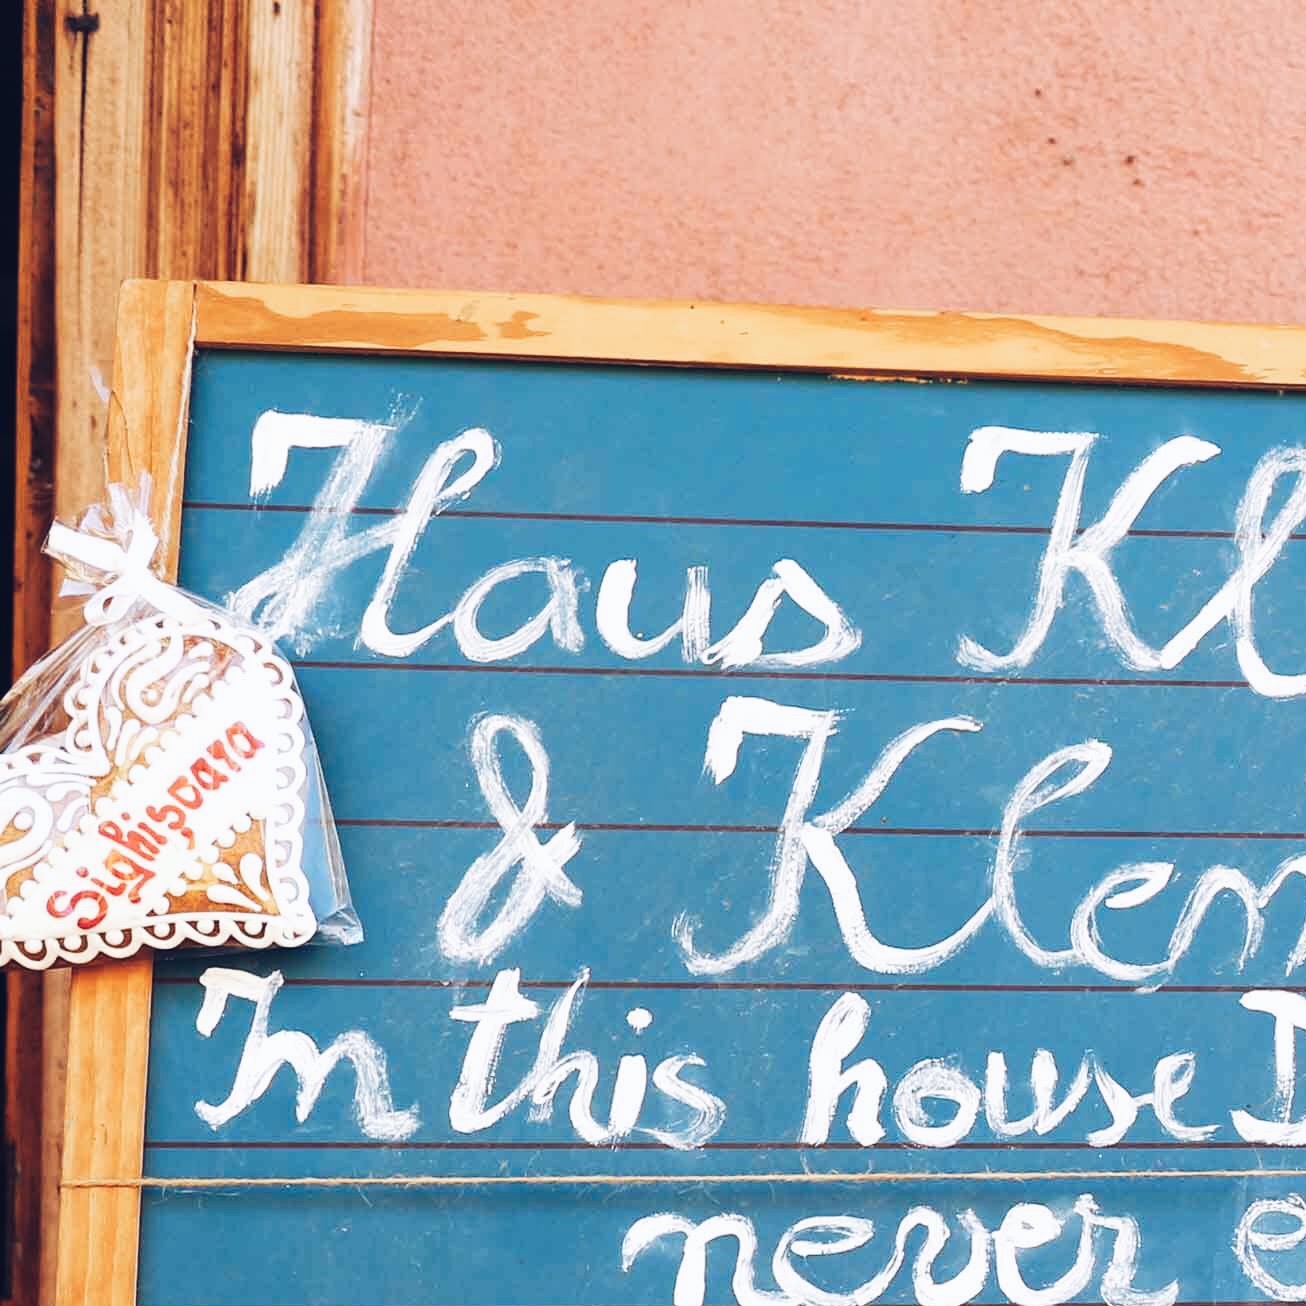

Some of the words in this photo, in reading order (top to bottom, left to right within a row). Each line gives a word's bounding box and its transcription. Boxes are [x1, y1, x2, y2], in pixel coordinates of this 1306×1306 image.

[230, 398, 862, 668] Haus
[437, 711, 586, 966] &
[449, 966, 727, 1150] this
[801, 990, 1221, 1148] house
